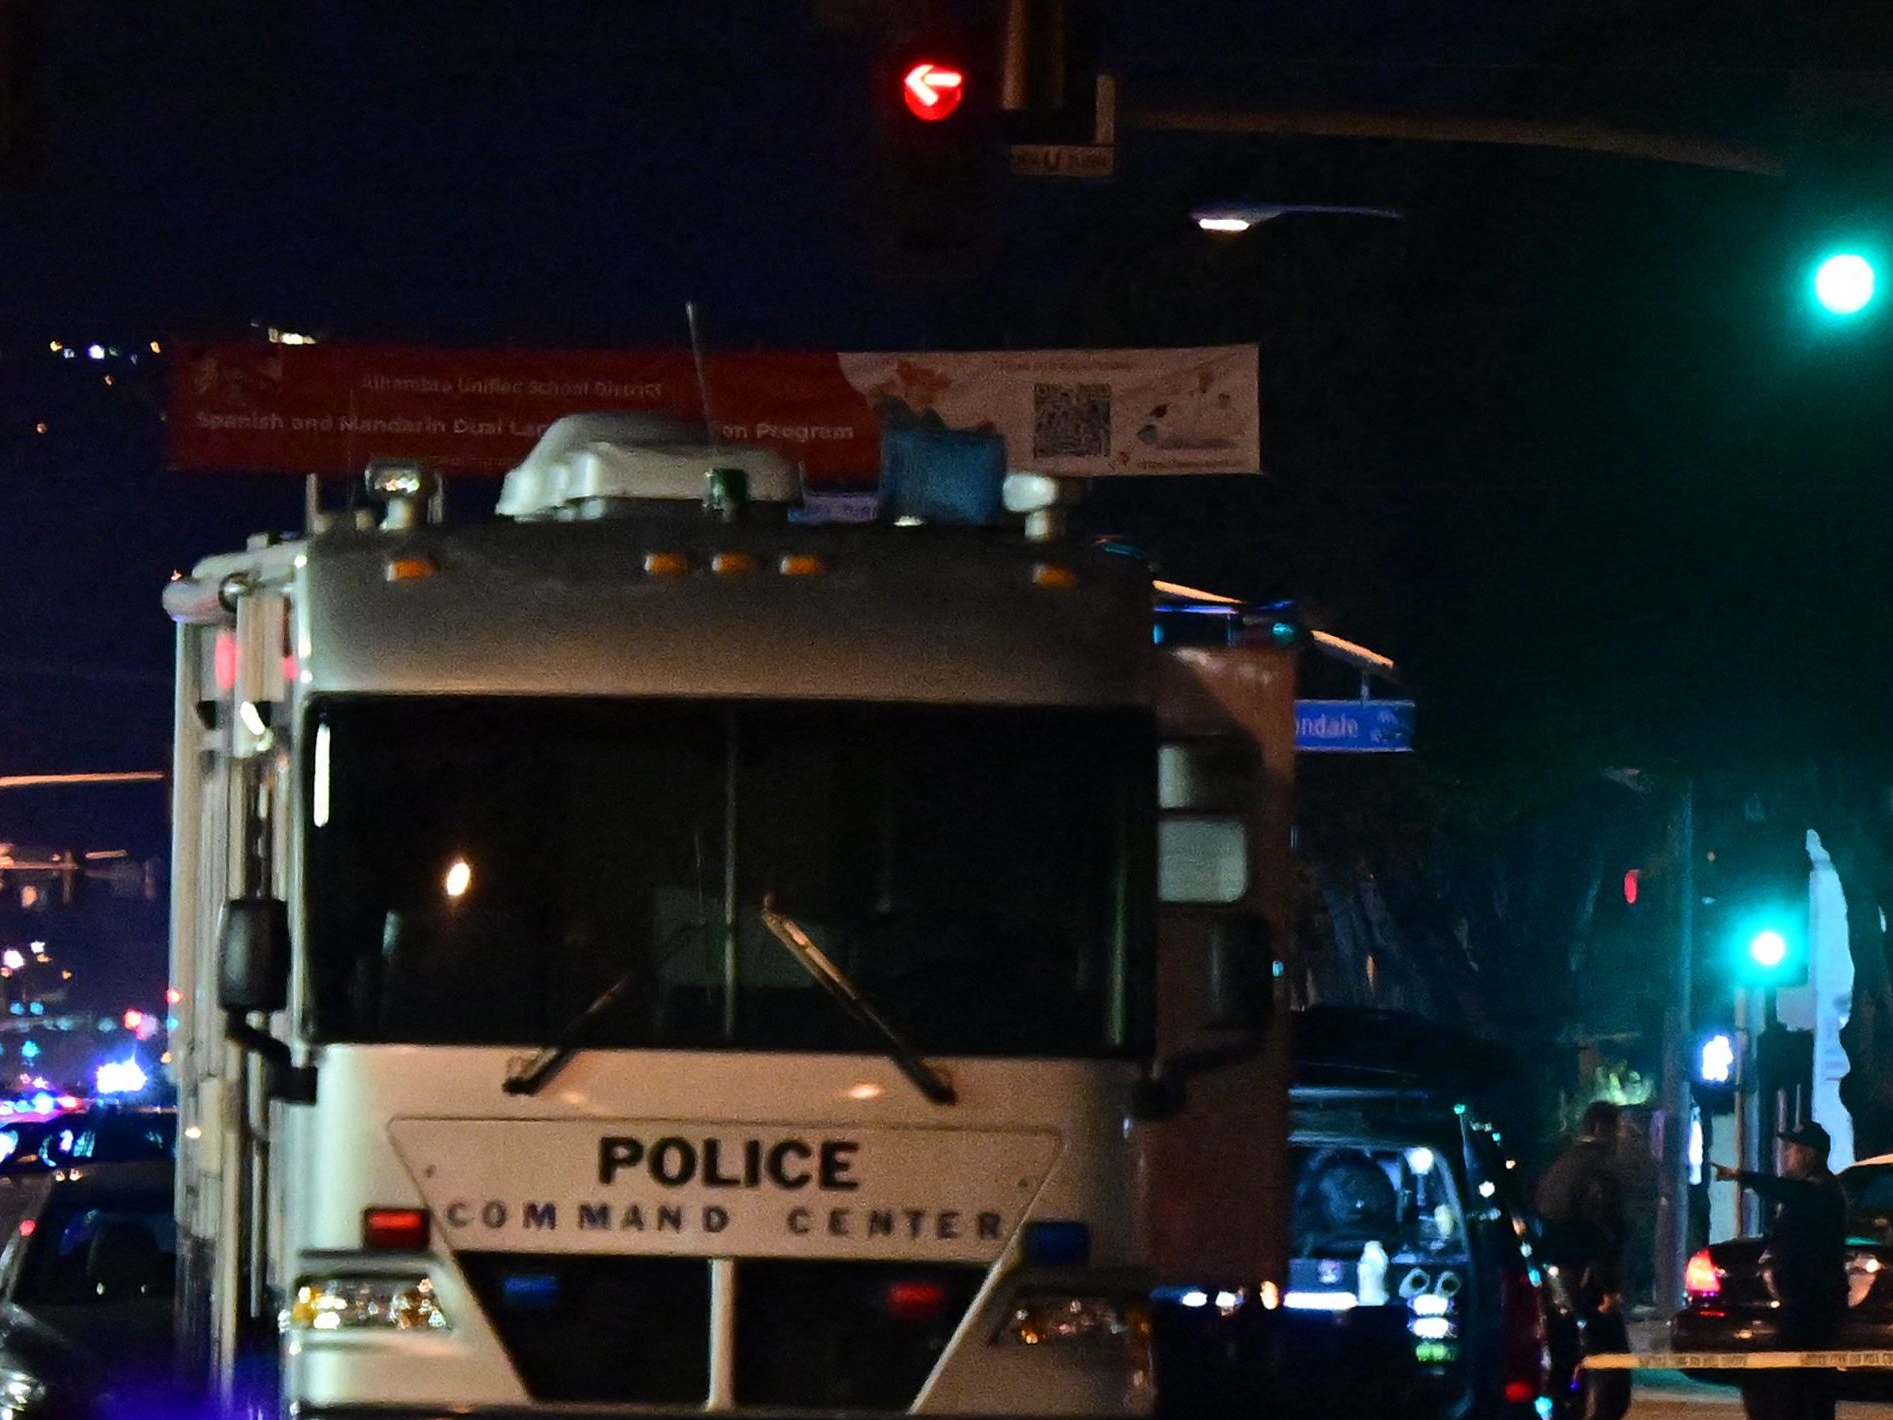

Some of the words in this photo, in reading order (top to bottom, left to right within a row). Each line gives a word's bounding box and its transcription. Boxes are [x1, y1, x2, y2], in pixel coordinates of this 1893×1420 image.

[195, 411, 285, 431] Spanish
[291, 413, 334, 432] and
[339, 415, 446, 434] Mandarin
[453, 417, 503, 435] Dual
[755, 422, 855, 442] Program
[597, 1136, 860, 1191] POLICE
[448, 1201, 731, 1234] COMMAND
[786, 1206, 1004, 1239] CENTER
